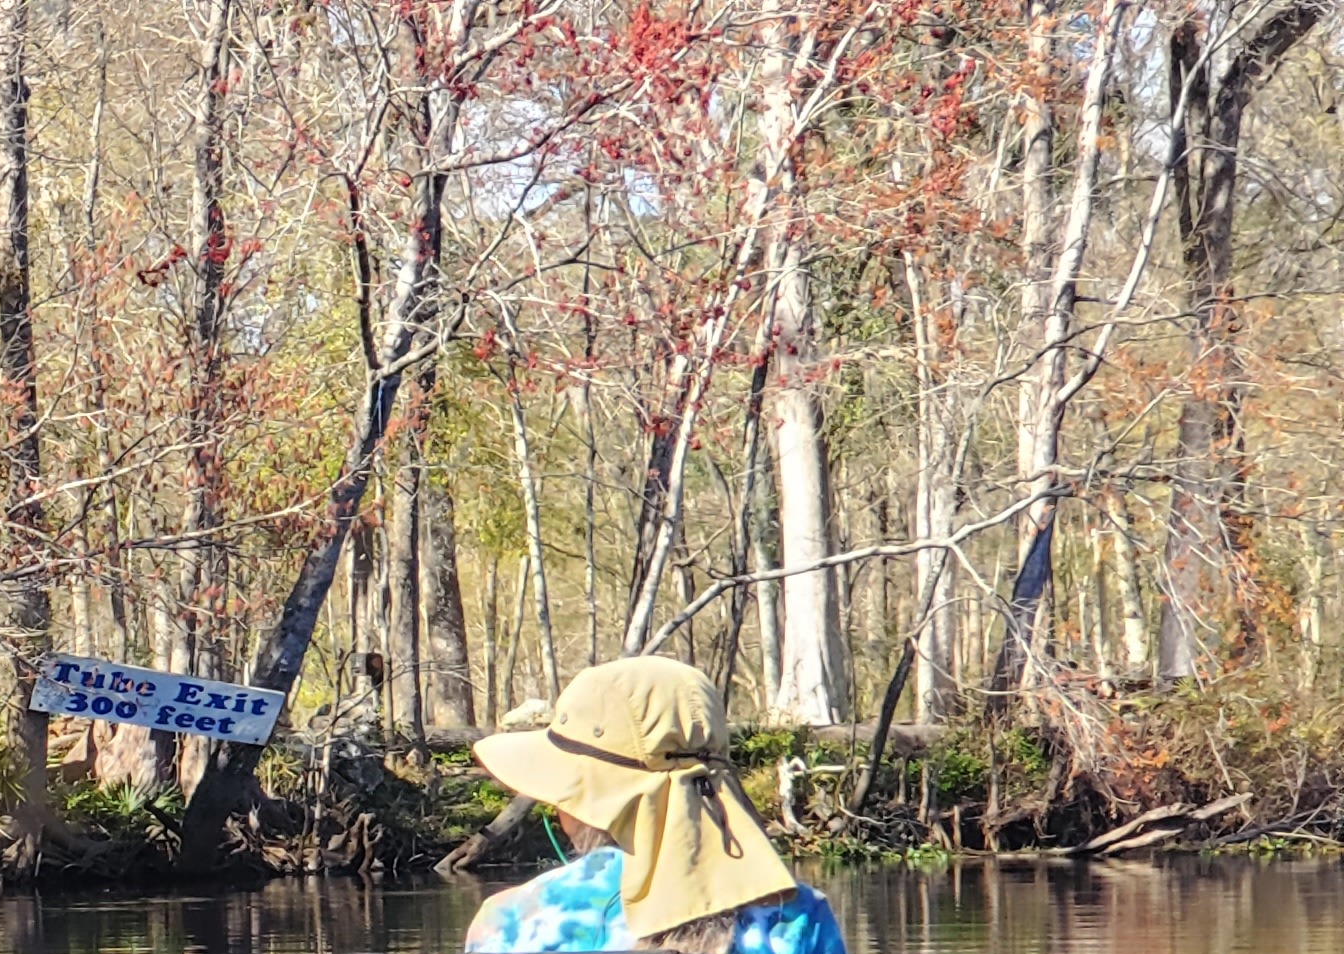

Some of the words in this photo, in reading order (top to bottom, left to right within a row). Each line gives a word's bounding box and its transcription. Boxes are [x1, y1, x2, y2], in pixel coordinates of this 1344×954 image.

[54, 660, 156, 698] Tube
[173, 682, 269, 716] Exit
[65, 692, 138, 719] 300
[154, 705, 236, 734] feet
